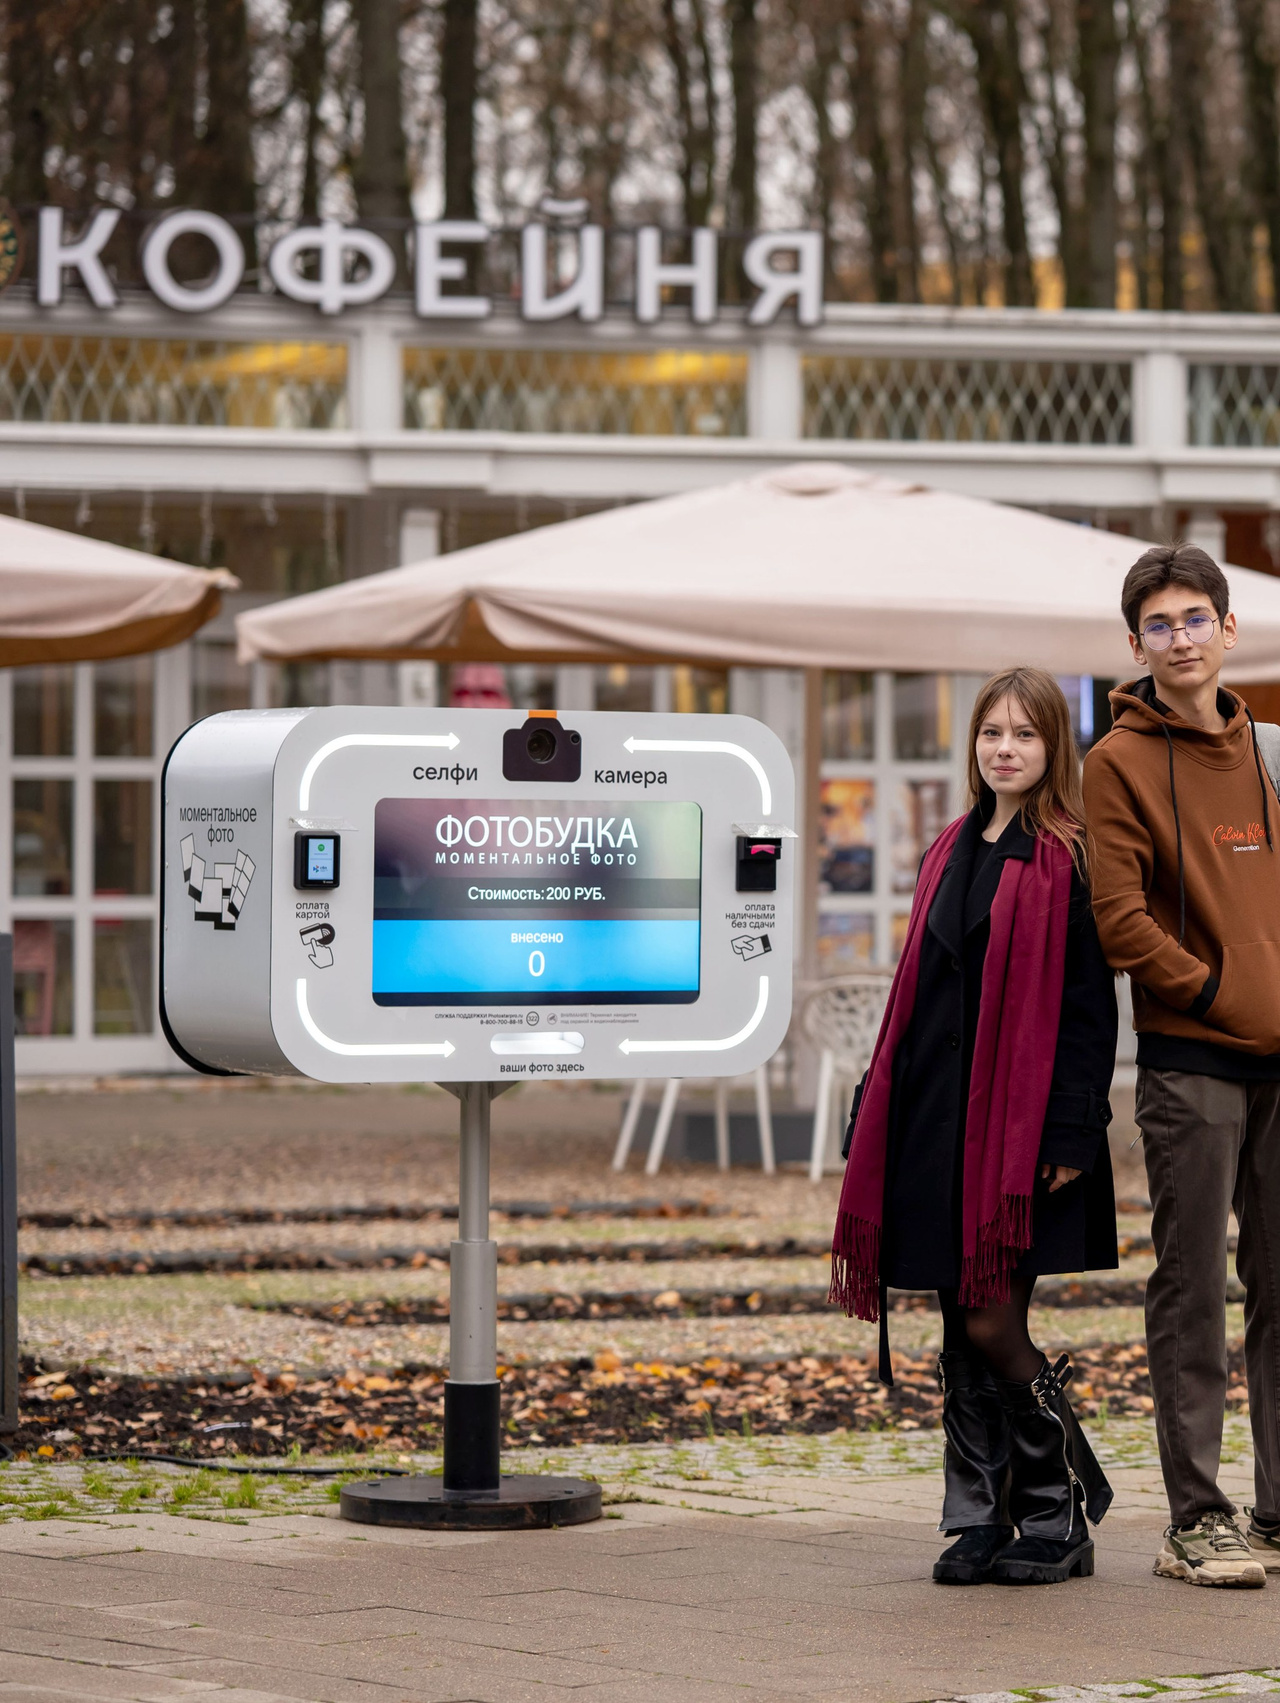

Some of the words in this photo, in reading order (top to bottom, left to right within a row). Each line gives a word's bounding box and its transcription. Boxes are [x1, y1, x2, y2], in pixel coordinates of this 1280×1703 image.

[38, 198, 826, 325] КОФЕЙНЯ
[412, 763, 478, 785] селфи
[594, 769, 668, 788] камера
[179, 807, 257, 823] моментальное
[207, 824, 235, 847] фото
[435, 814, 639, 854] ФОТОБУДКА
[1212, 824, 1246, 846] Calvin
[1247, 822, 1268, 844] Klei
[435, 852, 580, 865] МОМЕНТАЛЬНОЕ
[590, 853, 638, 866] ФОТО
[468, 886, 545, 900] Стоимость:
[546, 887, 571, 900] 200
[574, 887, 606, 900] РУБ.
[295, 902, 330, 911] оплата
[295, 909, 330, 920] картой
[731, 920, 747, 928] без
[749, 921, 775, 929] сдачи
[511, 932, 564, 943] внесено
[528, 950, 546, 977] 0
[500, 1064, 526, 1072] ваши
[528, 1062, 554, 1074] фото
[556, 1063, 585, 1072] здесь
